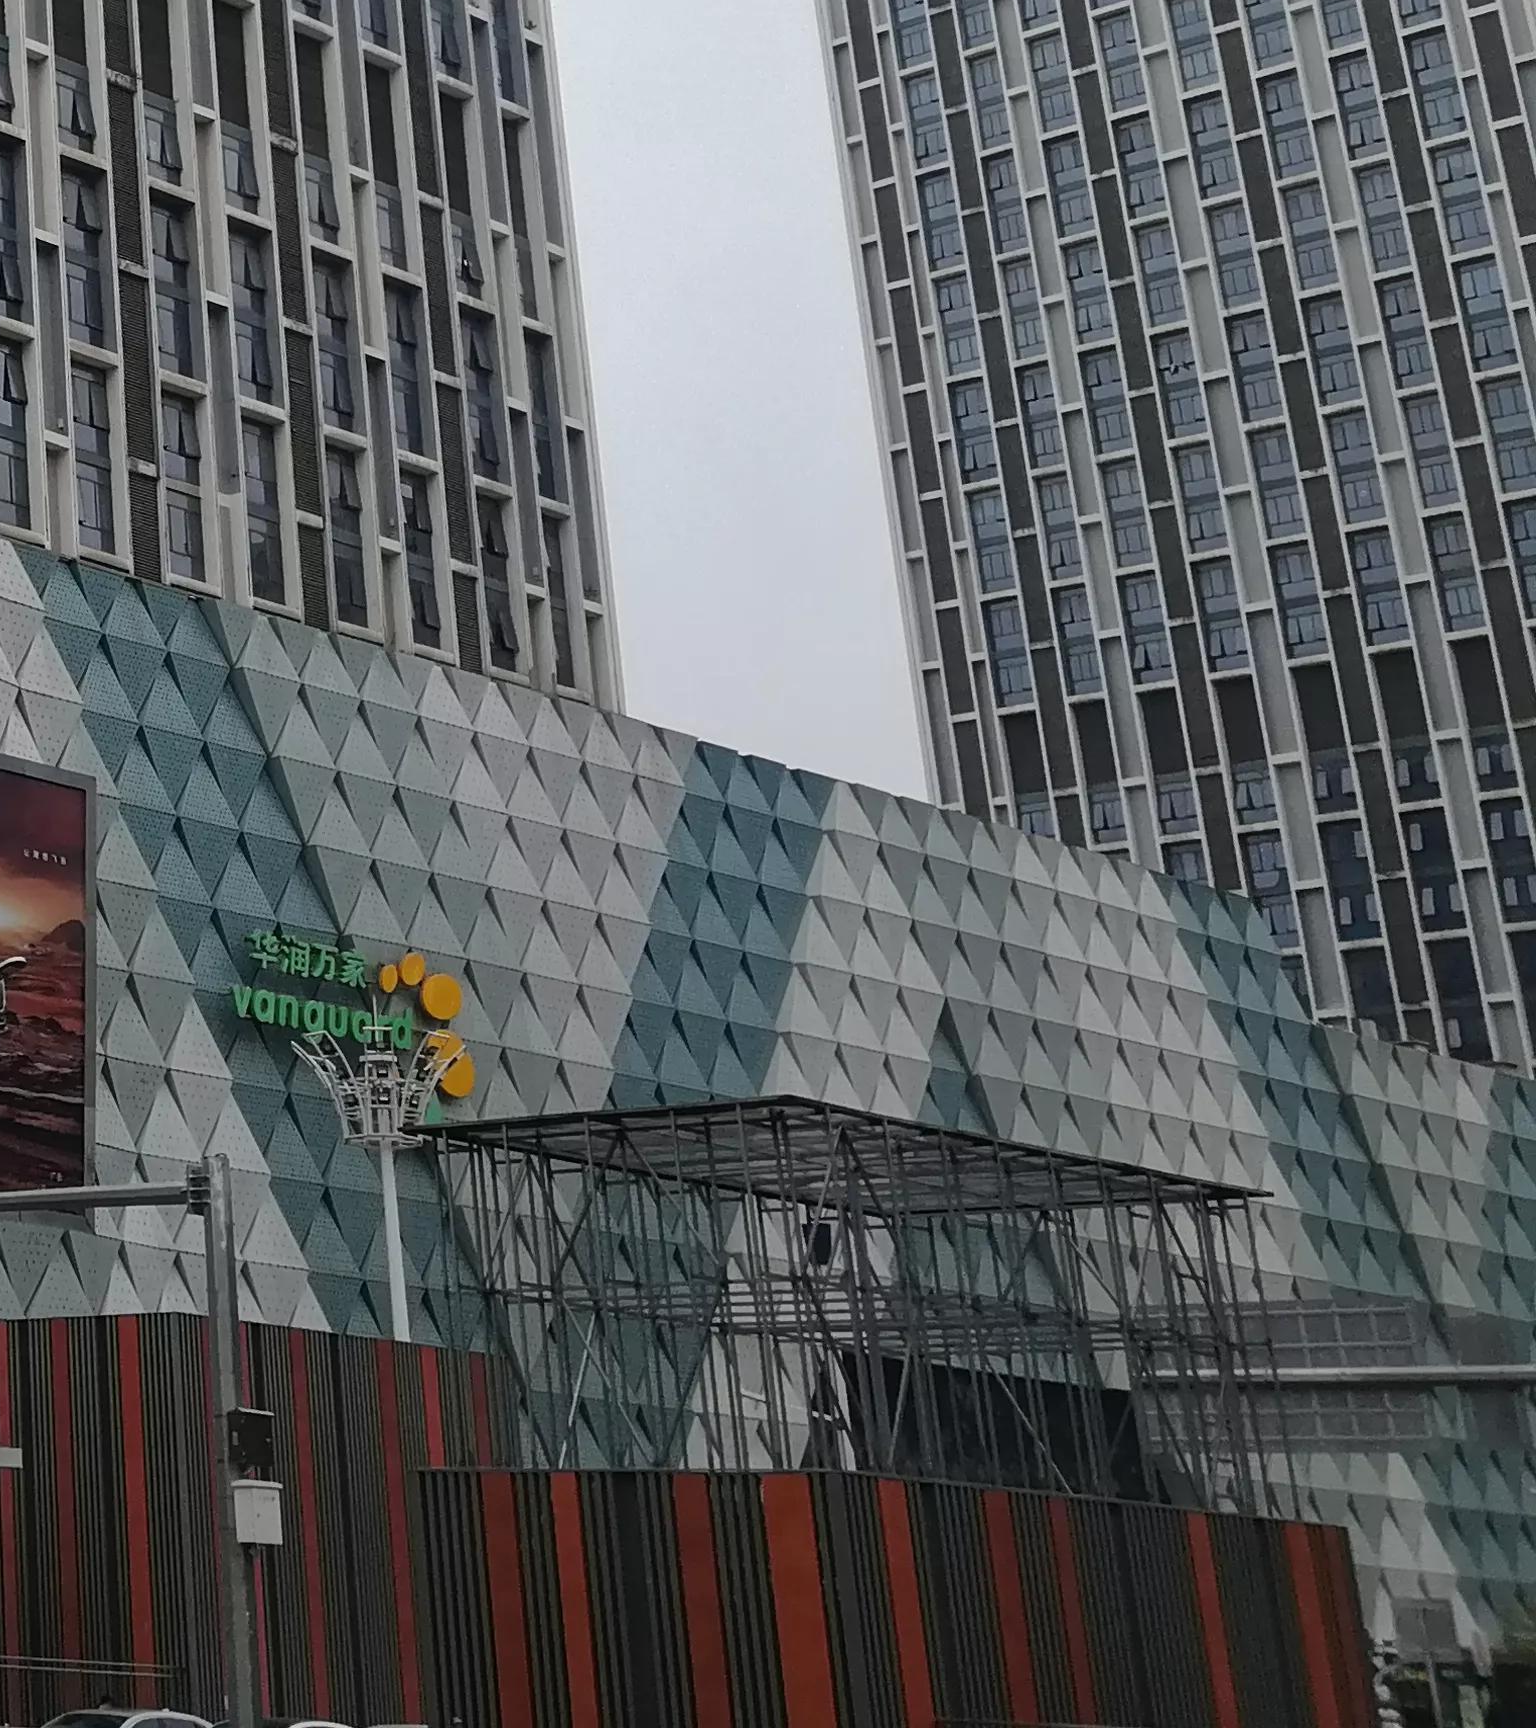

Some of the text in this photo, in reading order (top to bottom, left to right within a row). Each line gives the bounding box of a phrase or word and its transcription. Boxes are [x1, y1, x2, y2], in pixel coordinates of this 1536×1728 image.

[244, 929, 368, 989] 华润万家
[231, 984, 414, 1050] vanguard
